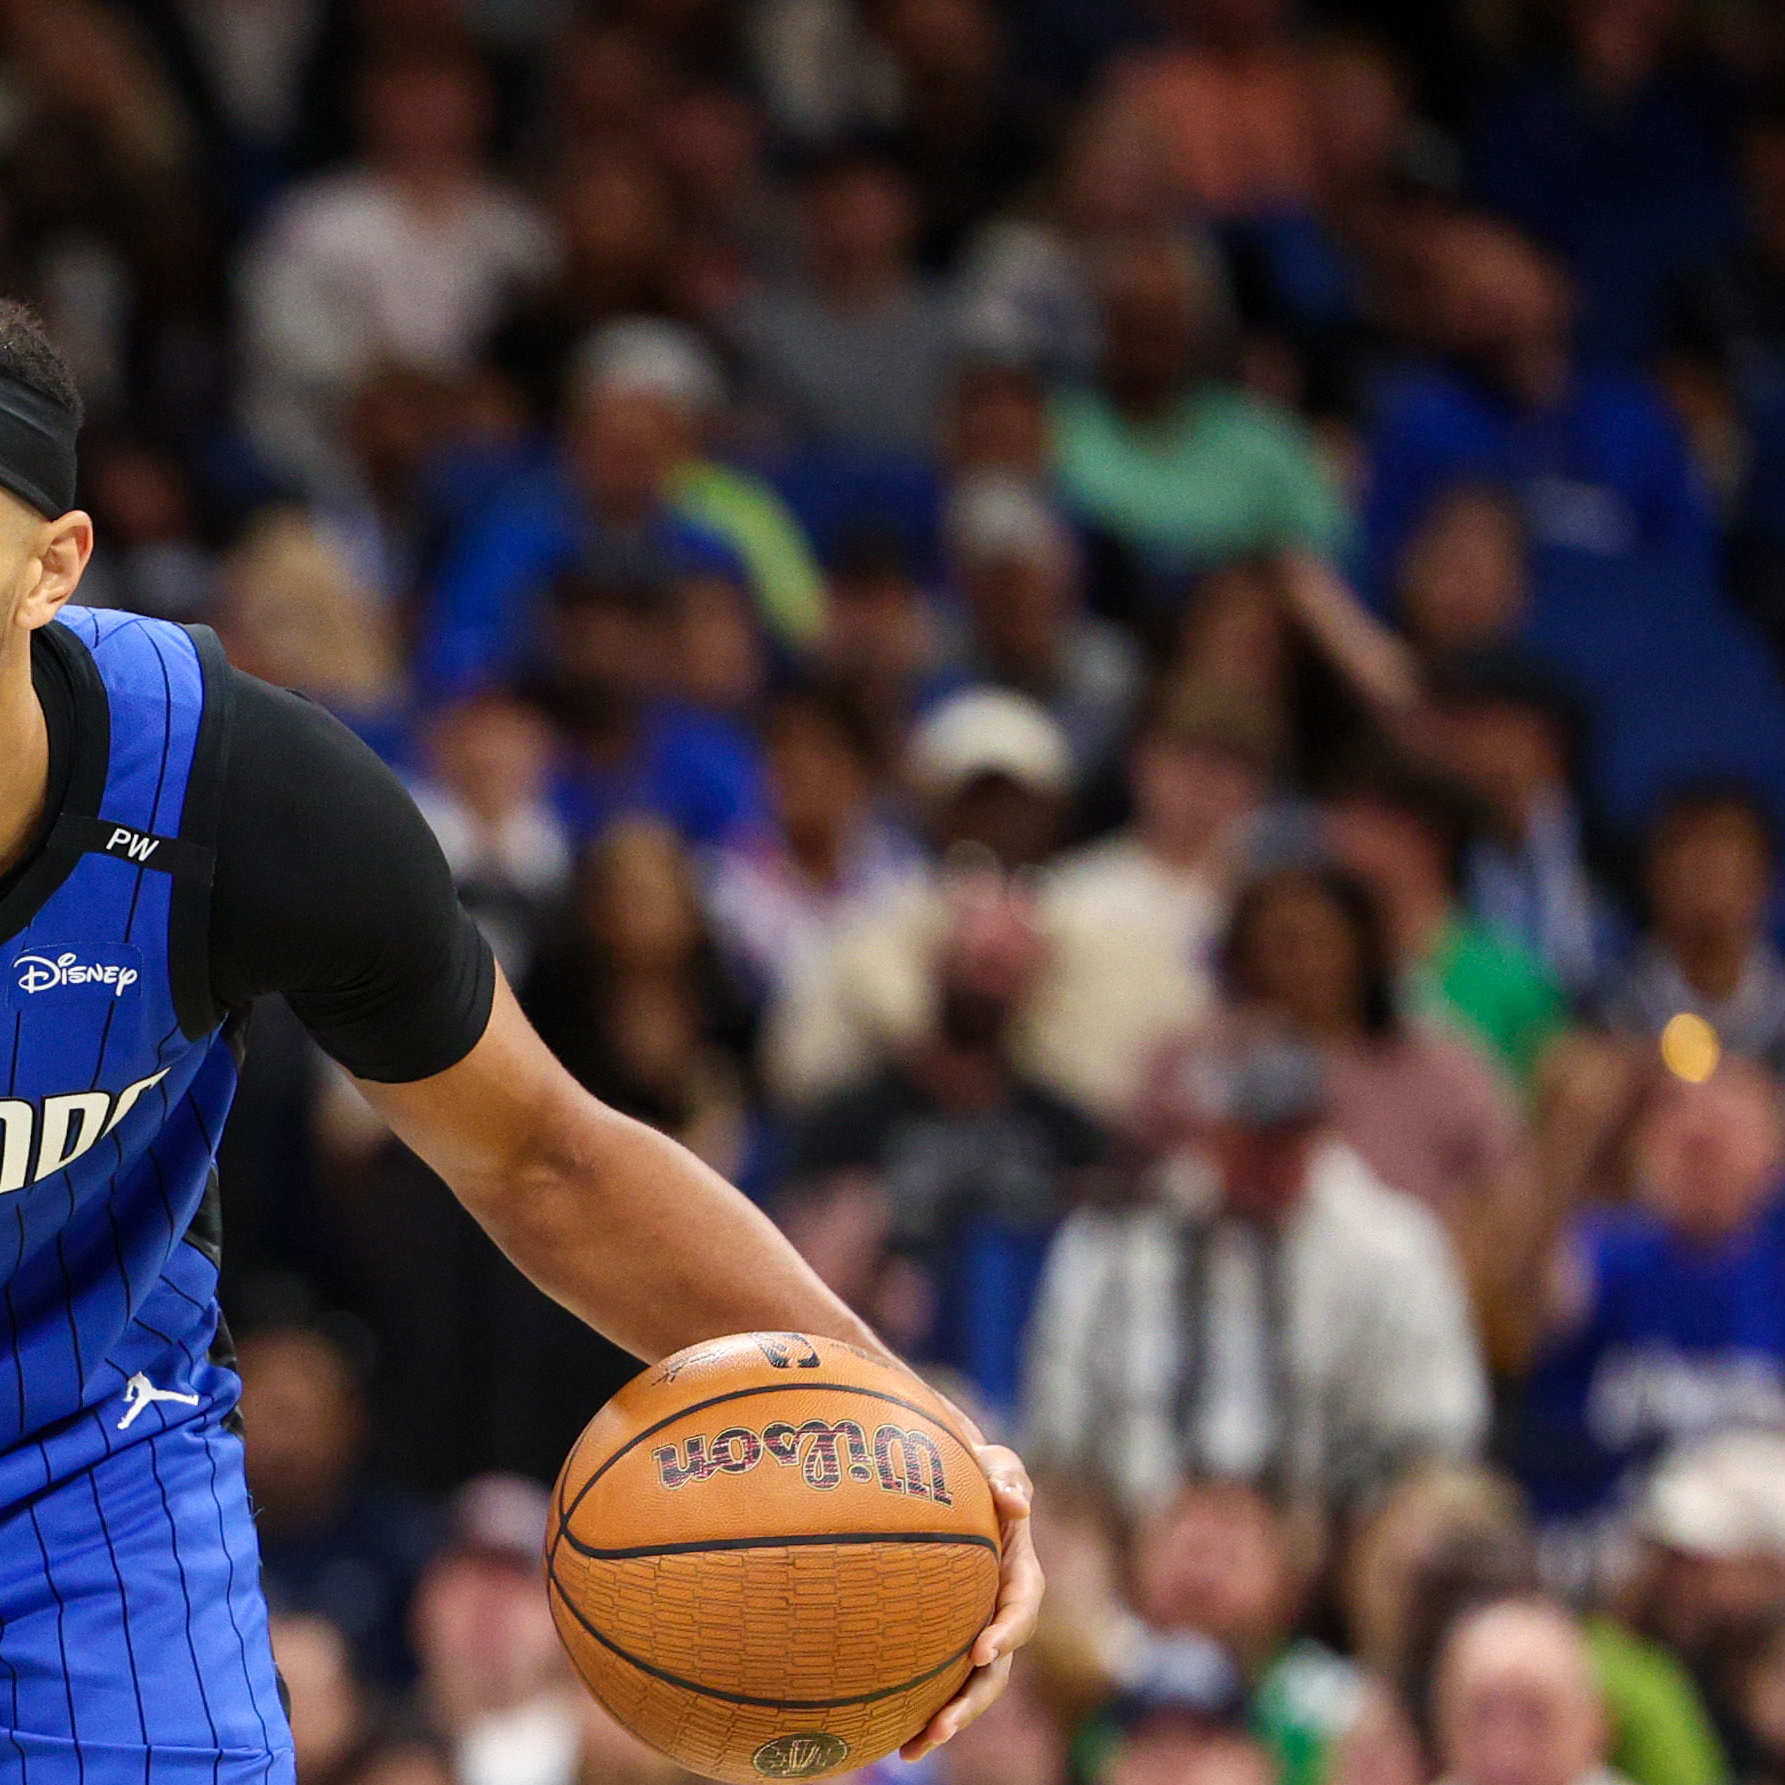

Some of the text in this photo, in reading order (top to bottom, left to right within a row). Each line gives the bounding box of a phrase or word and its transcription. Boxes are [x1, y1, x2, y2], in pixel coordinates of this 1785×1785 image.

[105, 827, 161, 862] PW
[13, 952, 138, 997] Disney
[652, 1419, 954, 1508] Wilson
